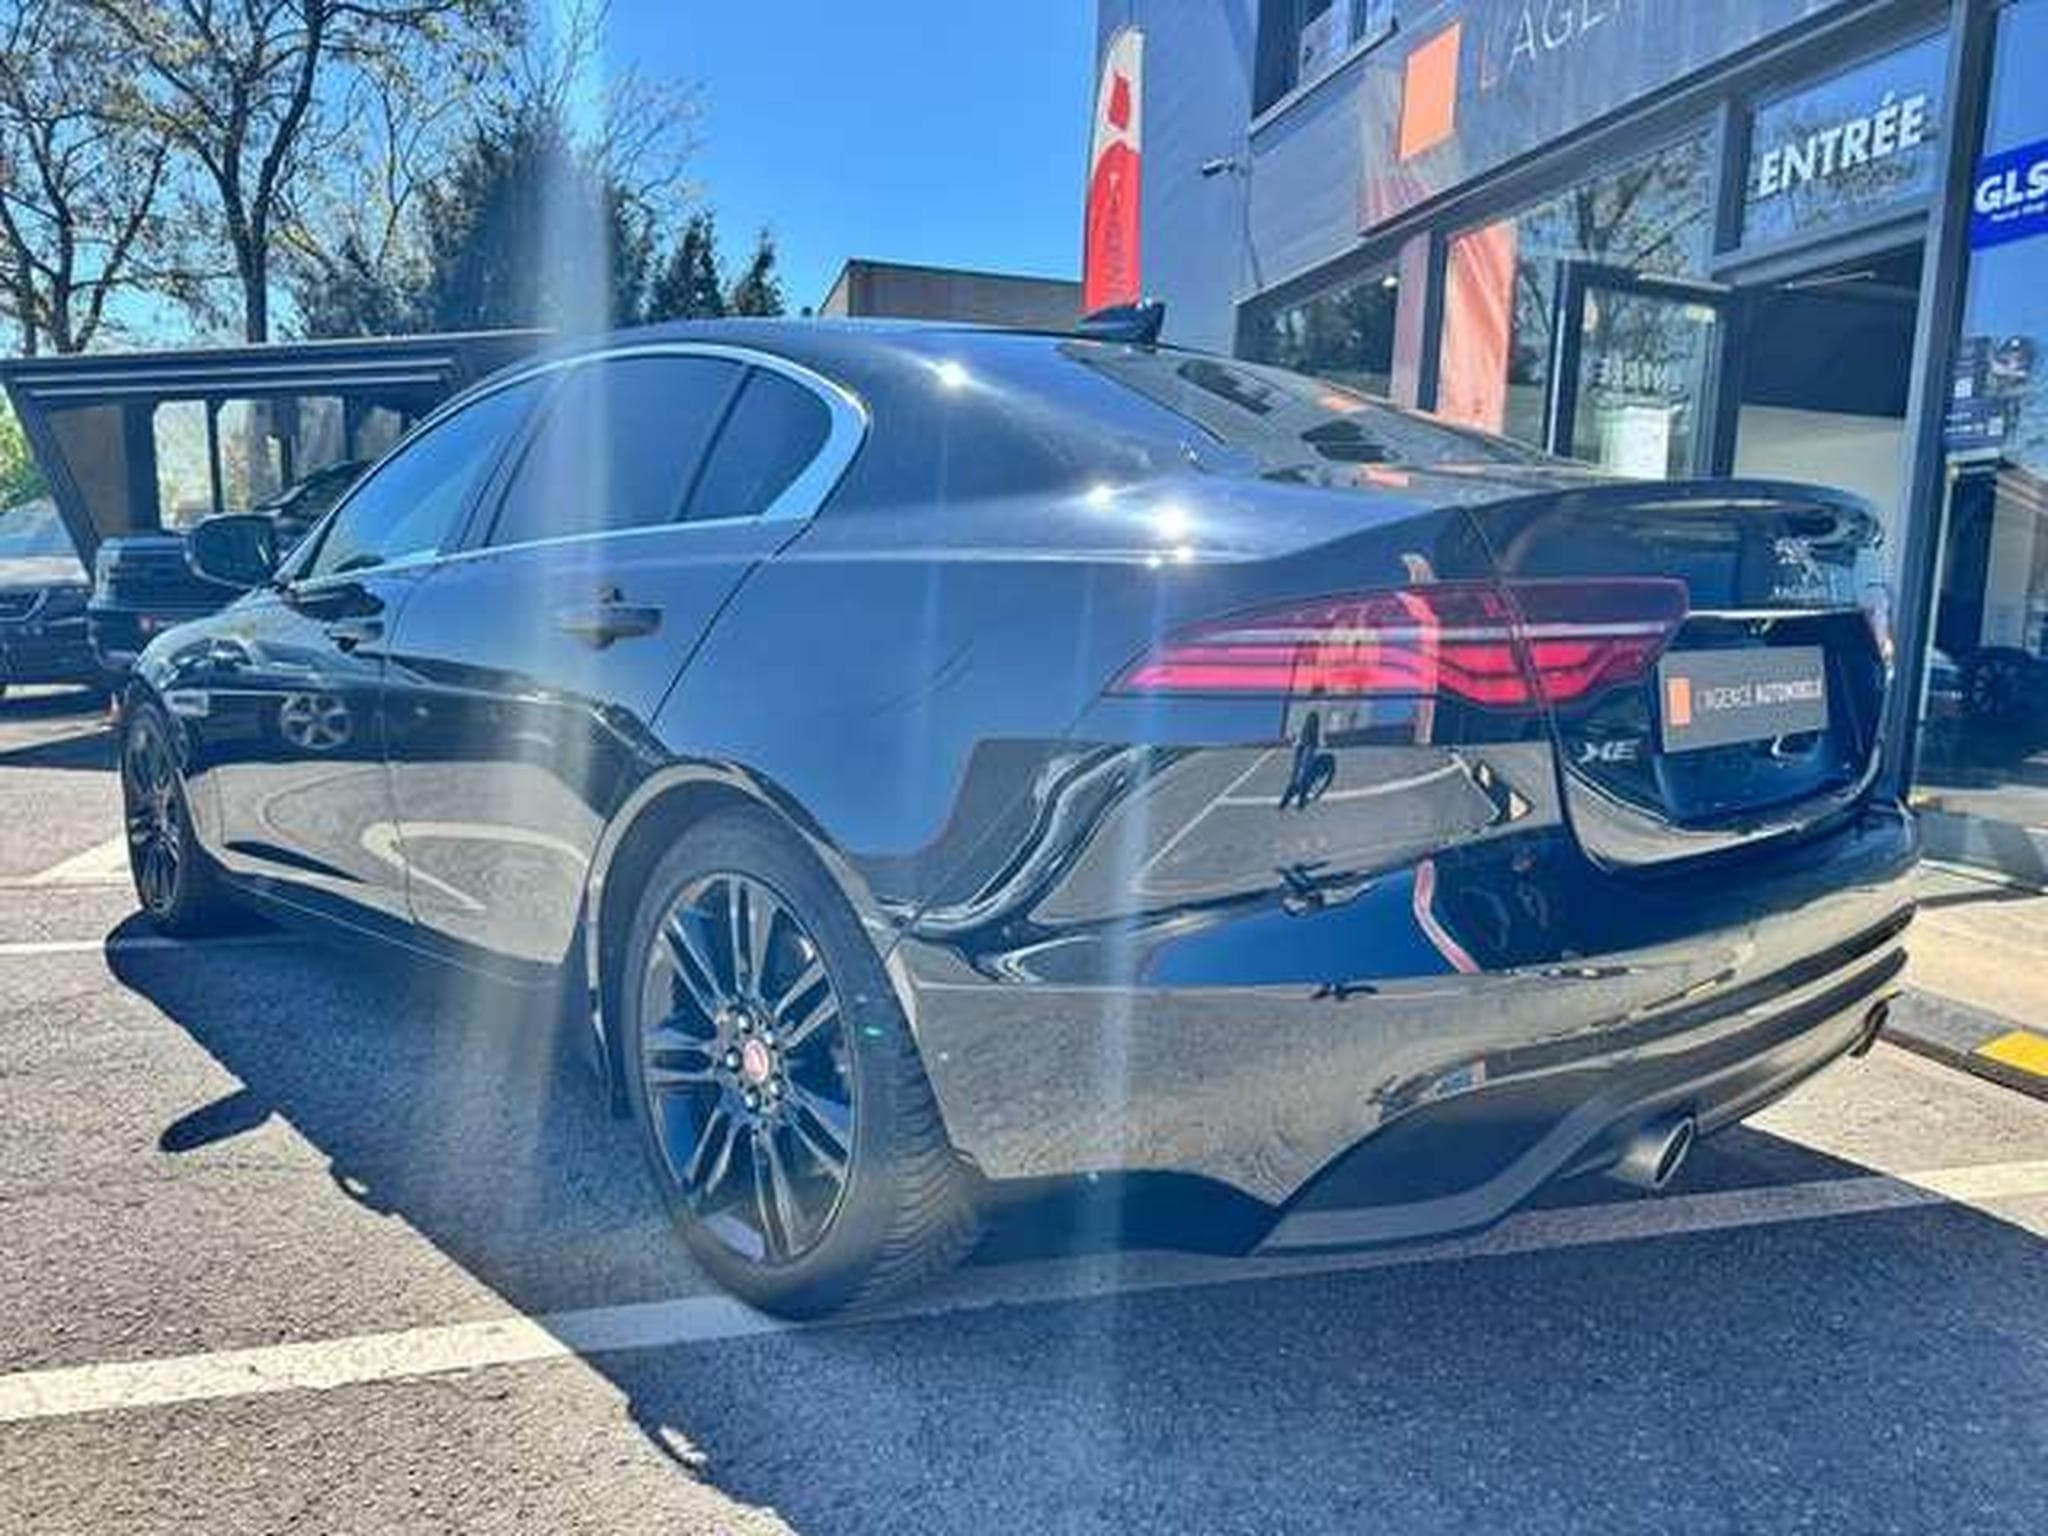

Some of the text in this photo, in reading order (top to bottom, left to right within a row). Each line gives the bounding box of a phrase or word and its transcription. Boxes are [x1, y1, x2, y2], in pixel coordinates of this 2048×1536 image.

[1757, 92, 1927, 196] ENTRÉE
[1974, 160, 2048, 213] GLS
[1578, 739, 1640, 764] XE
